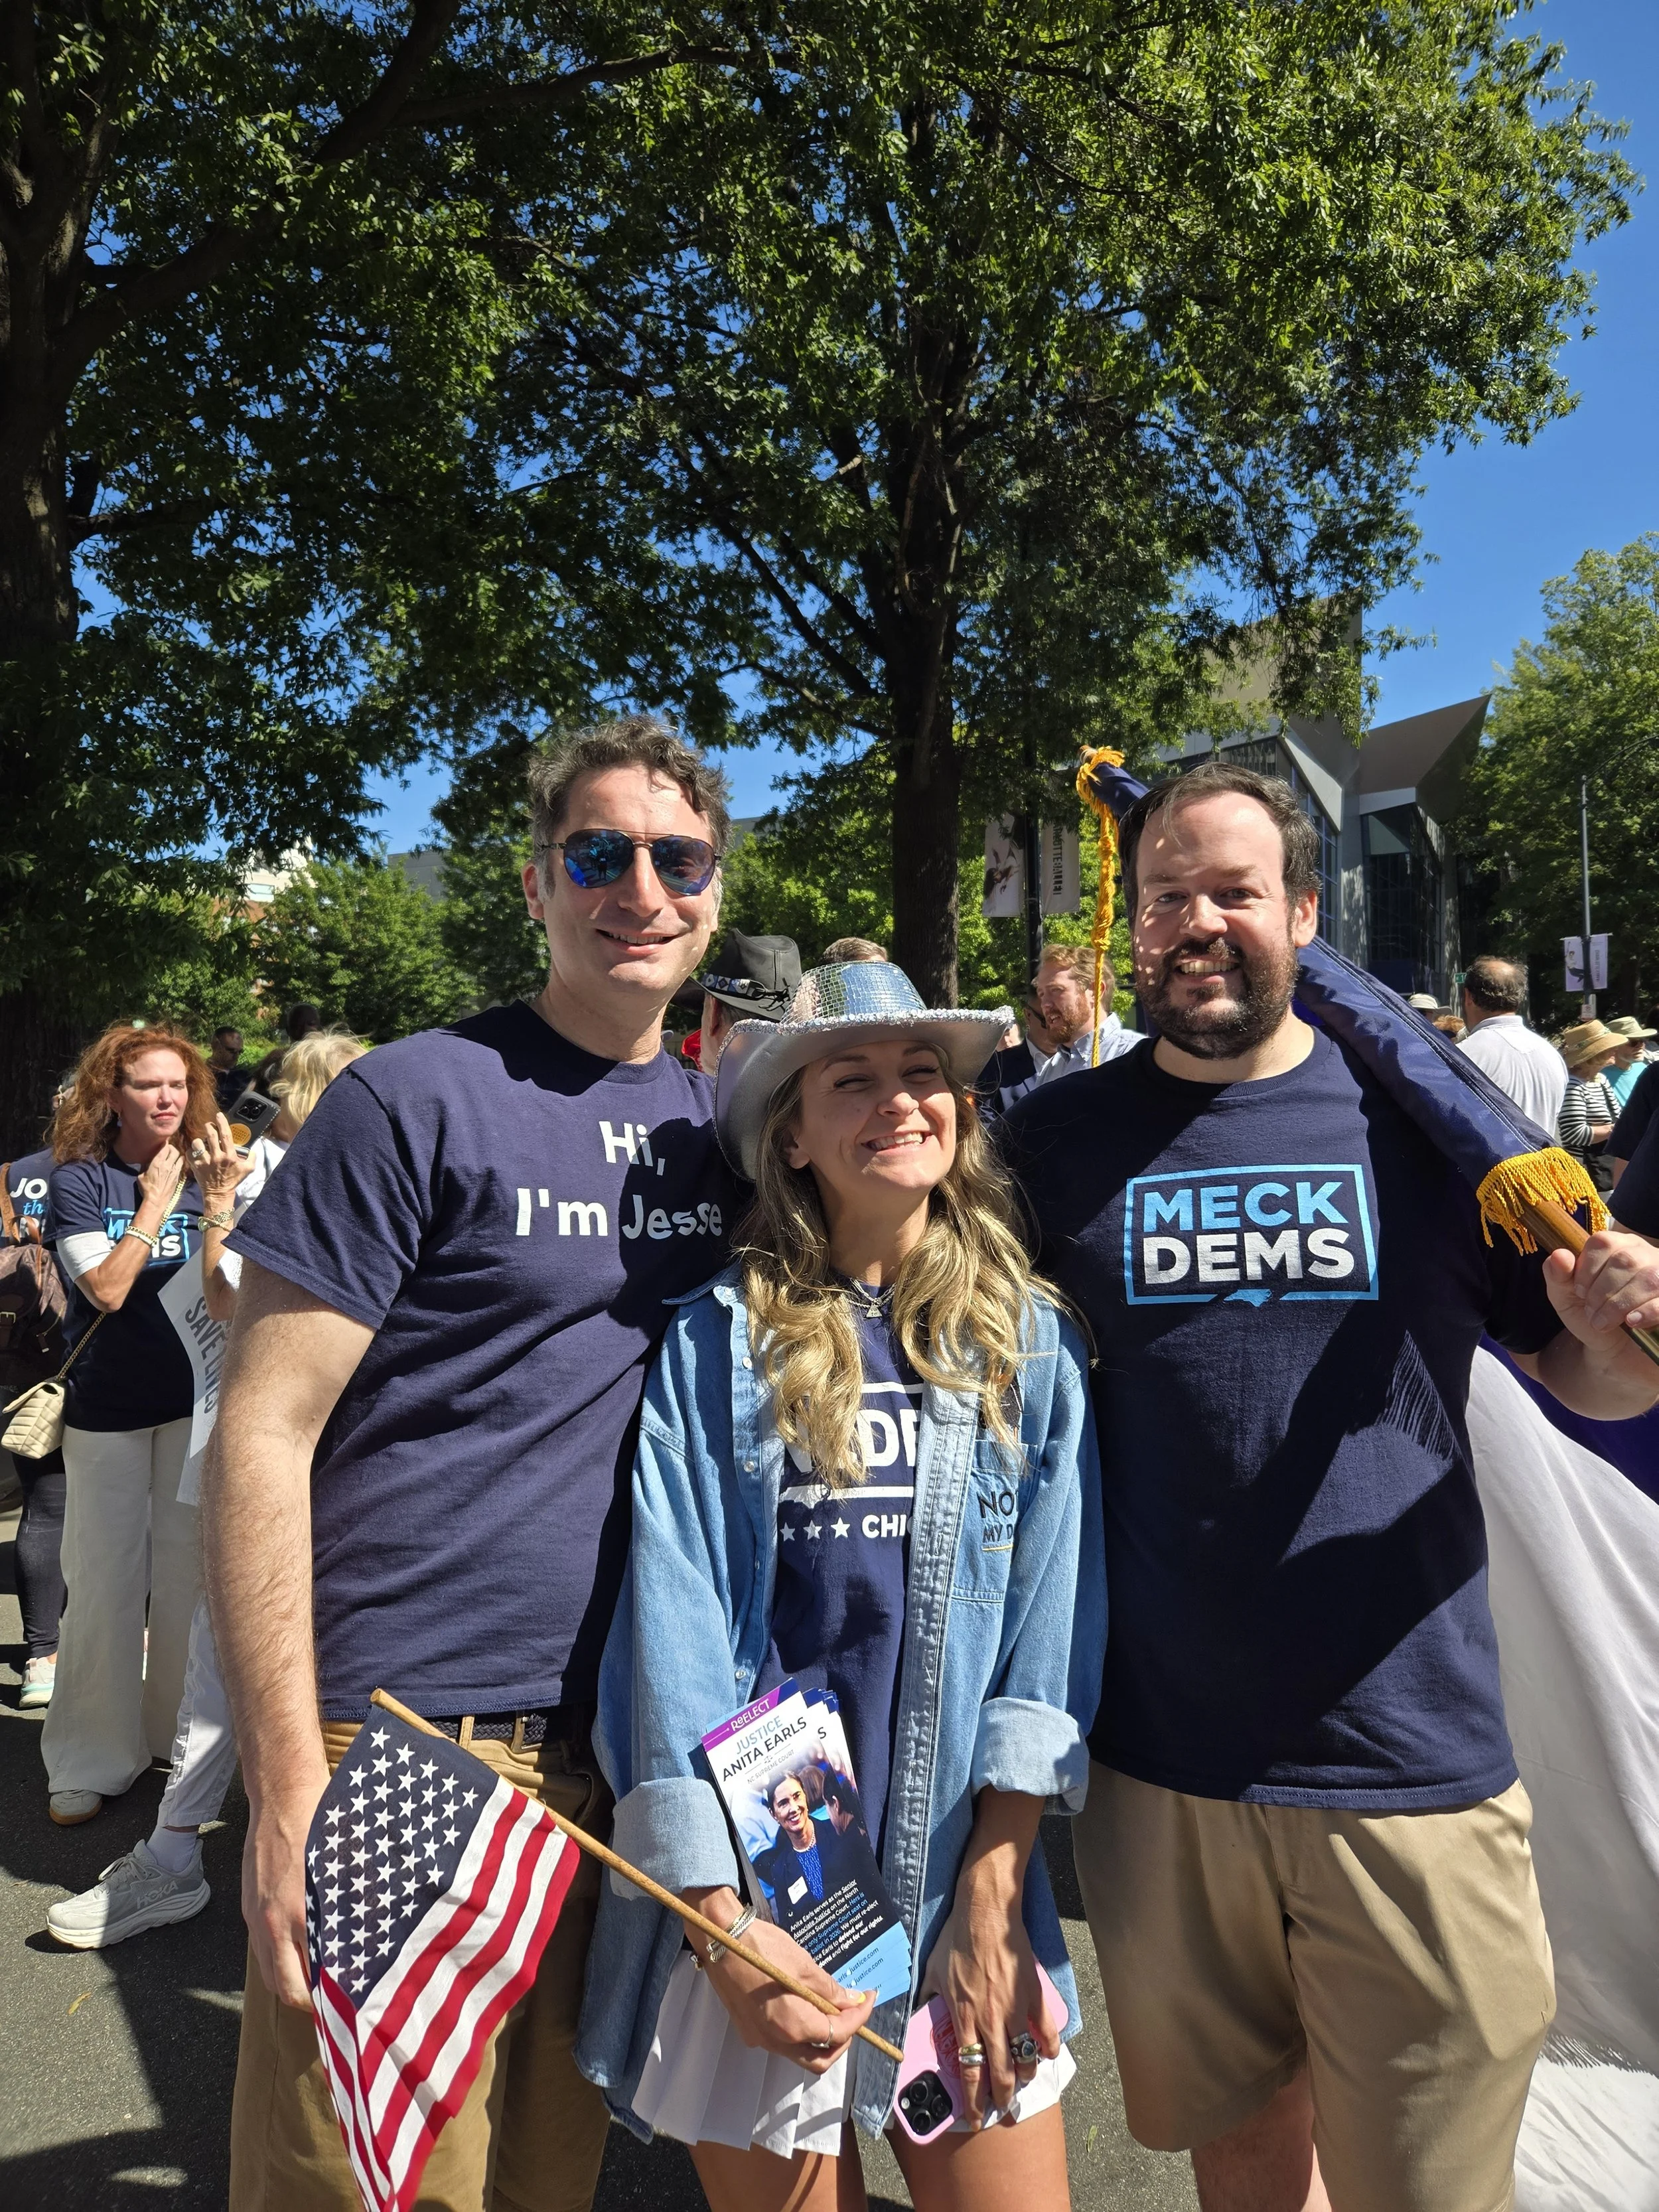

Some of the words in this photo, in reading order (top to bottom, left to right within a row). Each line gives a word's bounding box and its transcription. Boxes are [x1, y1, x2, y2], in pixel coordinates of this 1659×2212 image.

[599, 1120, 666, 1176] Hi,
[10, 1177, 47, 1199] JO
[23, 1199, 44, 1216] th
[1143, 1181, 1348, 1232] MECK
[107, 1217, 180, 1238] MK
[516, 1187, 608, 1236] I'm
[622, 1195, 722, 1240] Jesse
[1143, 1228, 1354, 1284] DEMS
[185, 1295, 226, 1361] SAVE
[983, 1524, 1003, 1543] MY
[1007, 1524, 1013, 1540] D
[723, 1747, 764, 1782] ANITA
[764, 1716, 807, 1753] EARLS
[737, 1716, 783, 1755] JUSTICE
[755, 1760, 778, 1779] SUPREME
[778, 1749, 795, 1764] COURT
[137, 1880, 179, 1909] HOKA
[790, 1918, 804, 1932] Anita
[802, 1911, 815, 1923] Earls
[814, 1900, 829, 1913] serves
[833, 1890, 842, 1899] the
[841, 1879, 857, 1894] Senior
[793, 1919, 816, 1939] Associate
[814, 1907, 831, 1924] Justice
[836, 1897, 845, 1906] the
[844, 1887, 859, 1900] North
[796, 1929, 816, 1946] Carolina
[814, 1915, 837, 1933] Supreme
[849, 1895, 861, 1906] Hers
[817, 1921, 839, 1939] Supreme
[837, 1911, 852, 1923] Court
[831, 1948, 841, 1958] and
